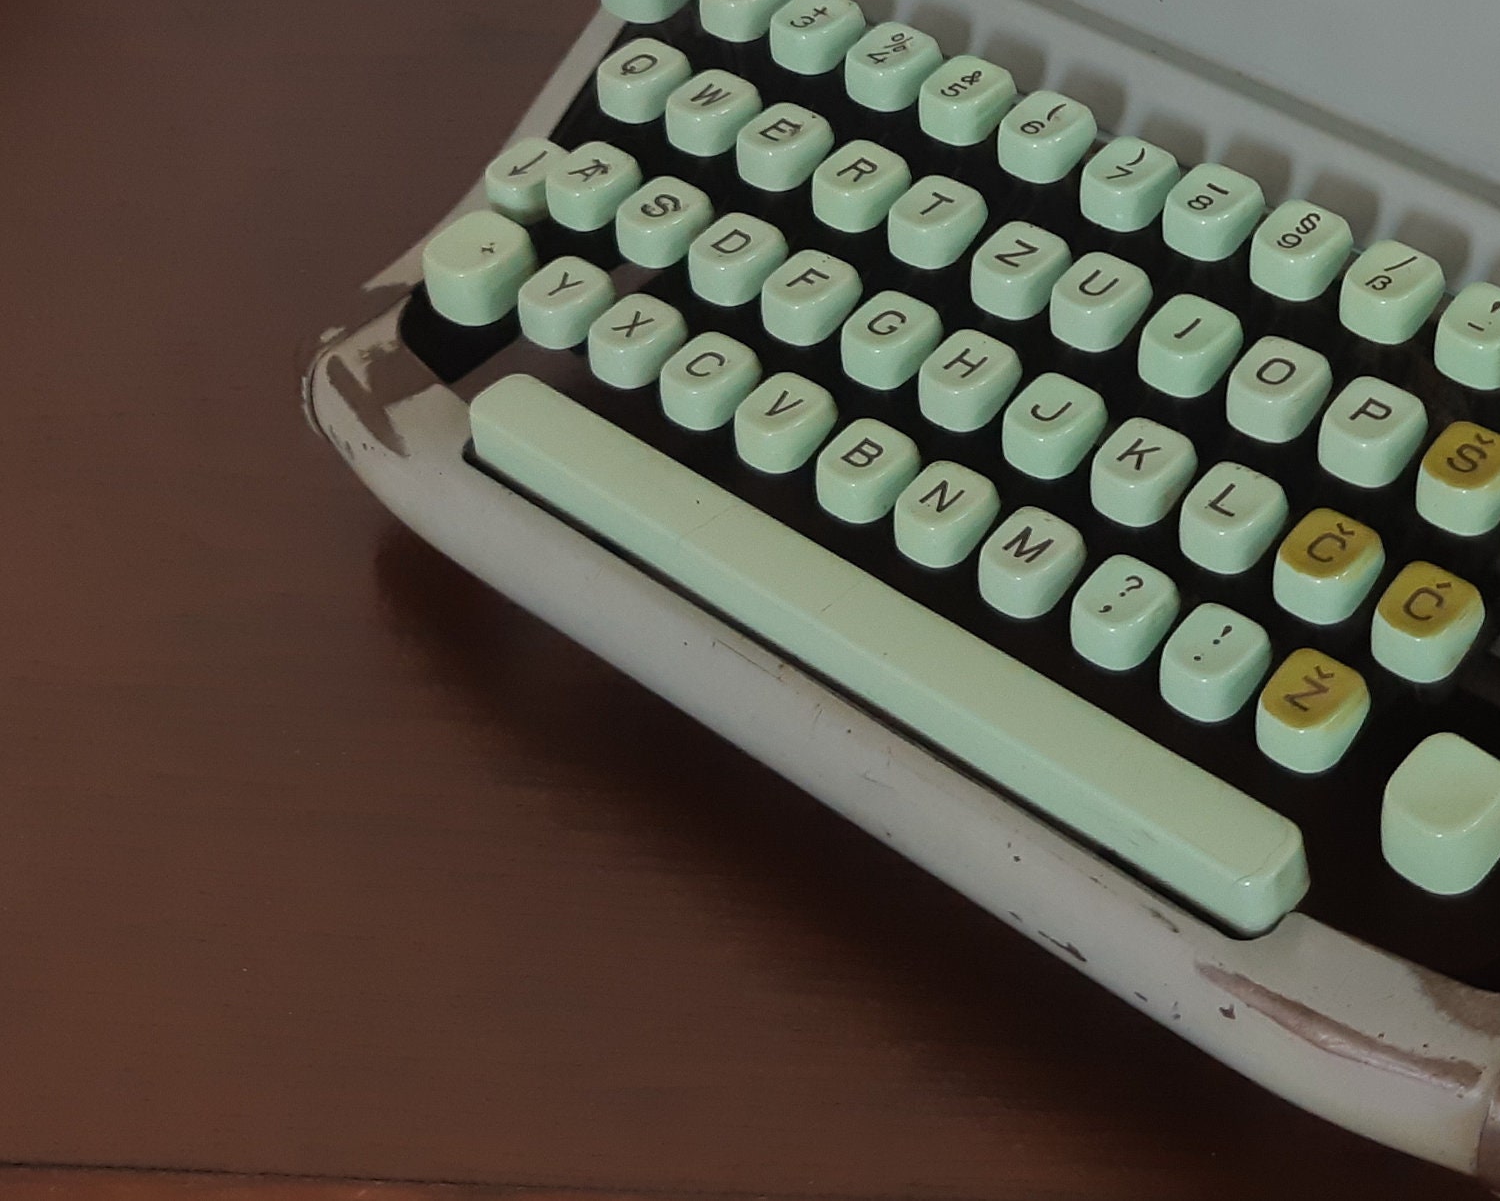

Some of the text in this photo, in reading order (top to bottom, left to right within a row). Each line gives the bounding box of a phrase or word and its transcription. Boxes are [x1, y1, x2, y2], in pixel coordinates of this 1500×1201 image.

[789, 16, 815, 29] 3
[620, 53, 659, 76] Q
[866, 51, 891, 65] 4
[940, 82, 963, 98] 5
[961, 70, 982, 86] &
[690, 83, 731, 107] W
[758, 117, 802, 146] E
[1020, 120, 1045, 135] 6
[836, 157, 878, 186] R
[1105, 165, 1134, 181] 7
[640, 193, 682, 218] S
[919, 191, 955, 215] T
[1186, 194, 1214, 211] 8
[710, 229, 752, 257] D
[993, 239, 1039, 268] Z
[1276, 233, 1302, 250] 9
[547, 271, 584, 297] Y
[785, 267, 830, 288] F
[1079, 269, 1119, 296] U
[611, 310, 655, 341] X
[867, 310, 908, 336] G
[685, 351, 725, 379] C
[942, 348, 988, 379] H
[1256, 358, 1297, 386] O
[764, 390, 804, 417] V
[1031, 400, 1073, 422] J
[1348, 397, 1392, 421] P
[840, 437, 885, 469] B
[1116, 437, 1162, 471] K
[1446, 432, 1495, 474] Š
[918, 480, 965, 514] N
[1206, 483, 1237, 518] L
[1002, 526, 1054, 563] M
[1306, 522, 1355, 564] Č
[1402, 581, 1452, 622] Ć
[1283, 665, 1335, 713] Ž
